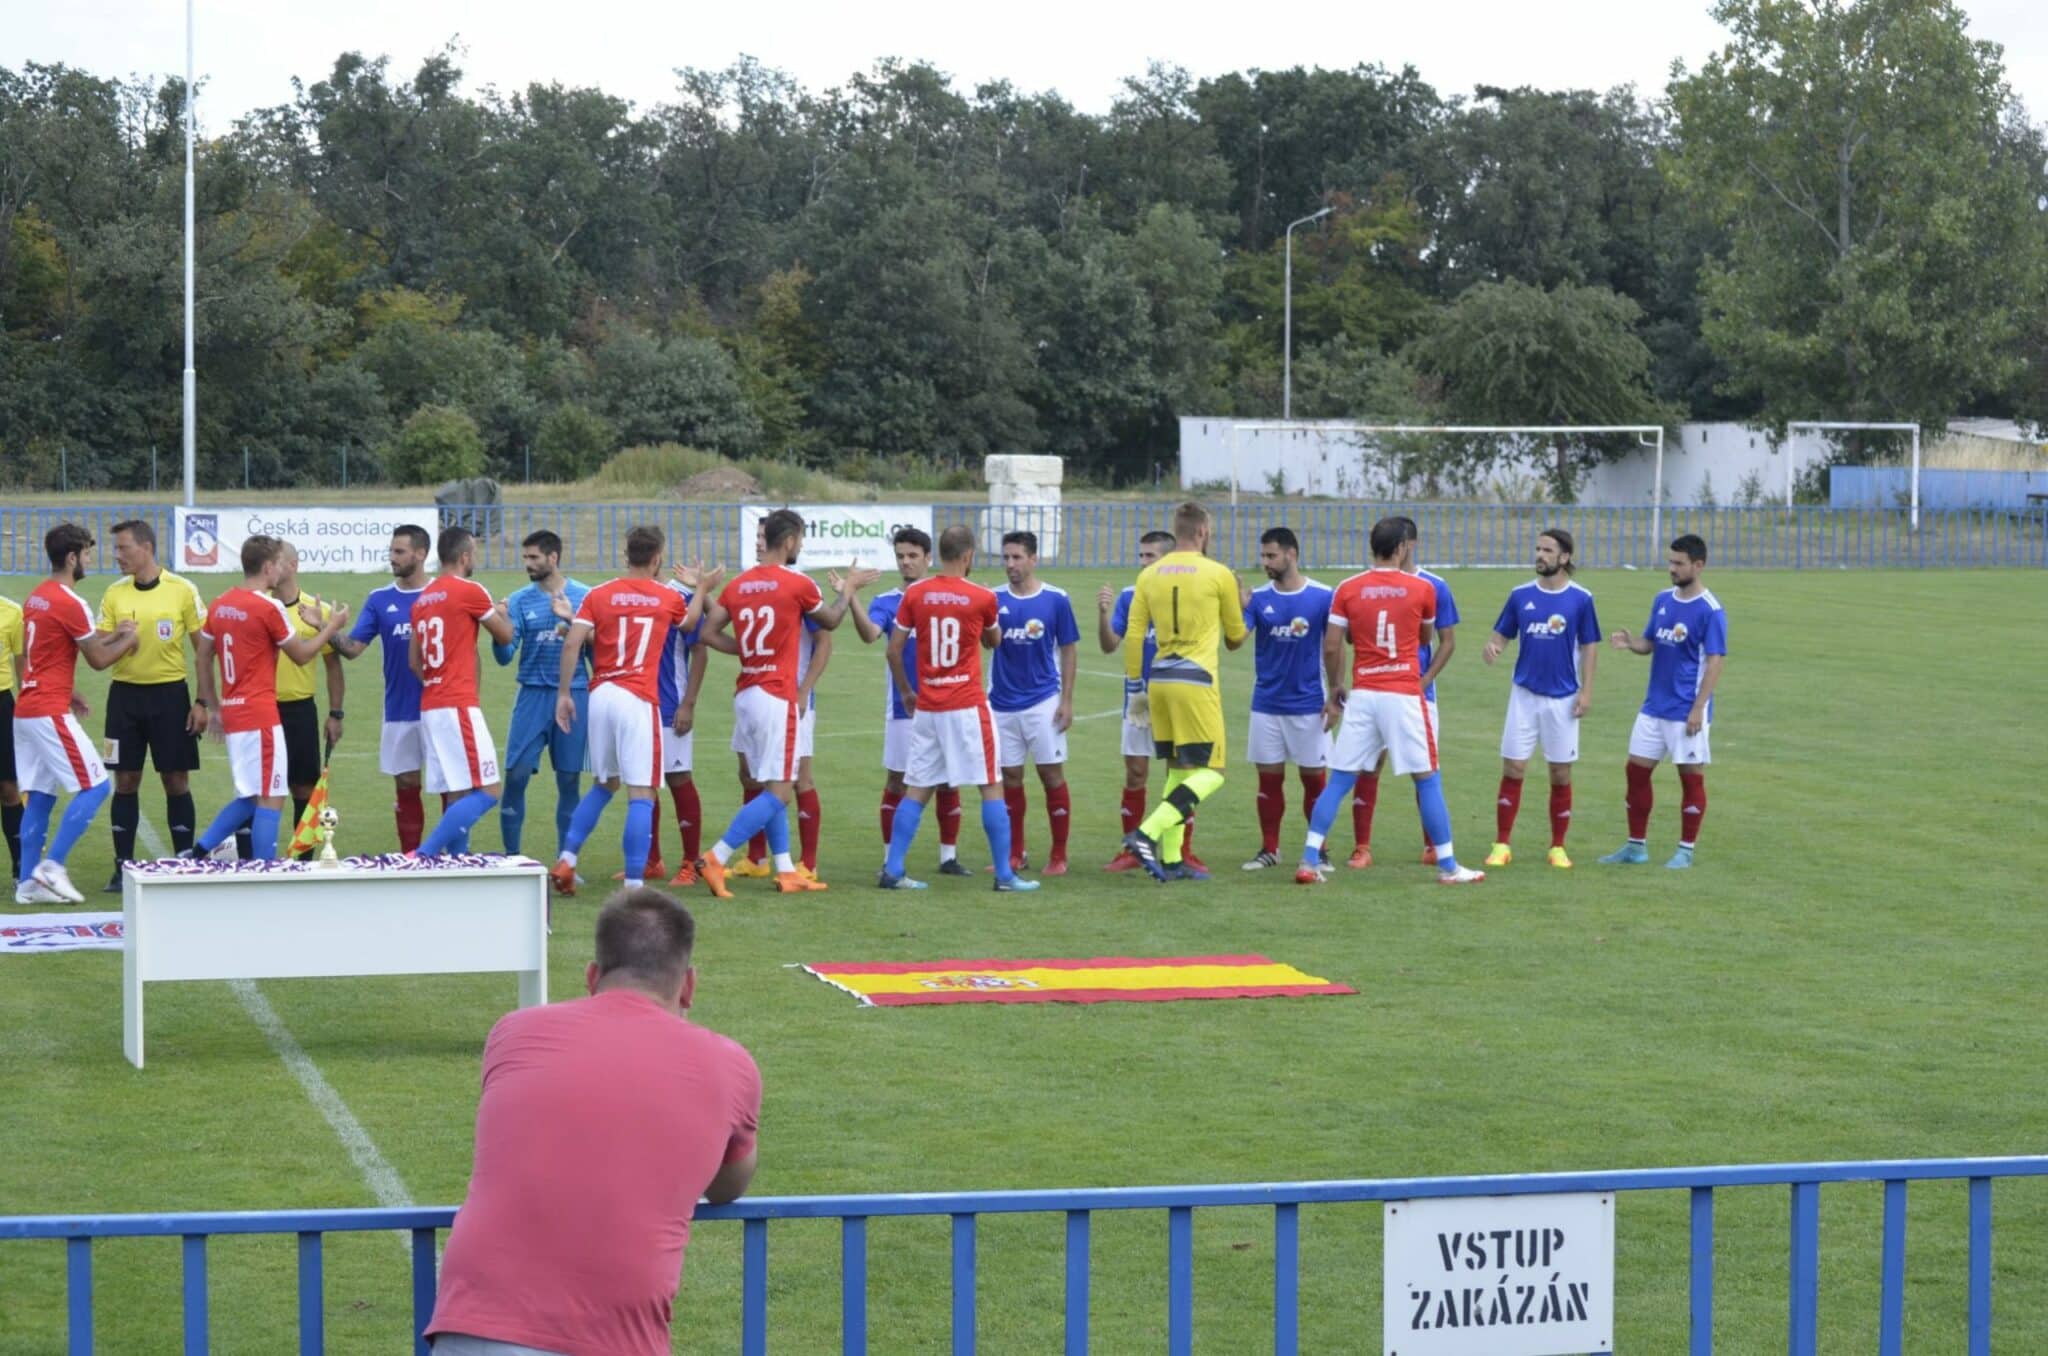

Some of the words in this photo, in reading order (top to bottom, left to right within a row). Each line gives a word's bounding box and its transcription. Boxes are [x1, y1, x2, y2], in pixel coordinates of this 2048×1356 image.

[247, 514, 309, 535] Česká
[297, 545, 354, 566] ových
[361, 545, 394, 562] hrá
[738, 605, 775, 658] 22
[1172, 586, 1179, 635] 1
[1376, 609, 1398, 659] 4
[222, 632, 236, 685] 6
[615, 616, 654, 668] 17
[930, 616, 960, 668] 18
[91, 762, 101, 778] 2
[273, 774, 281, 789] 6
[481, 760, 497, 777] 23
[1437, 1228, 1565, 1271] VSTUP
[1411, 1272, 1588, 1330] ZAKÁZÁN
